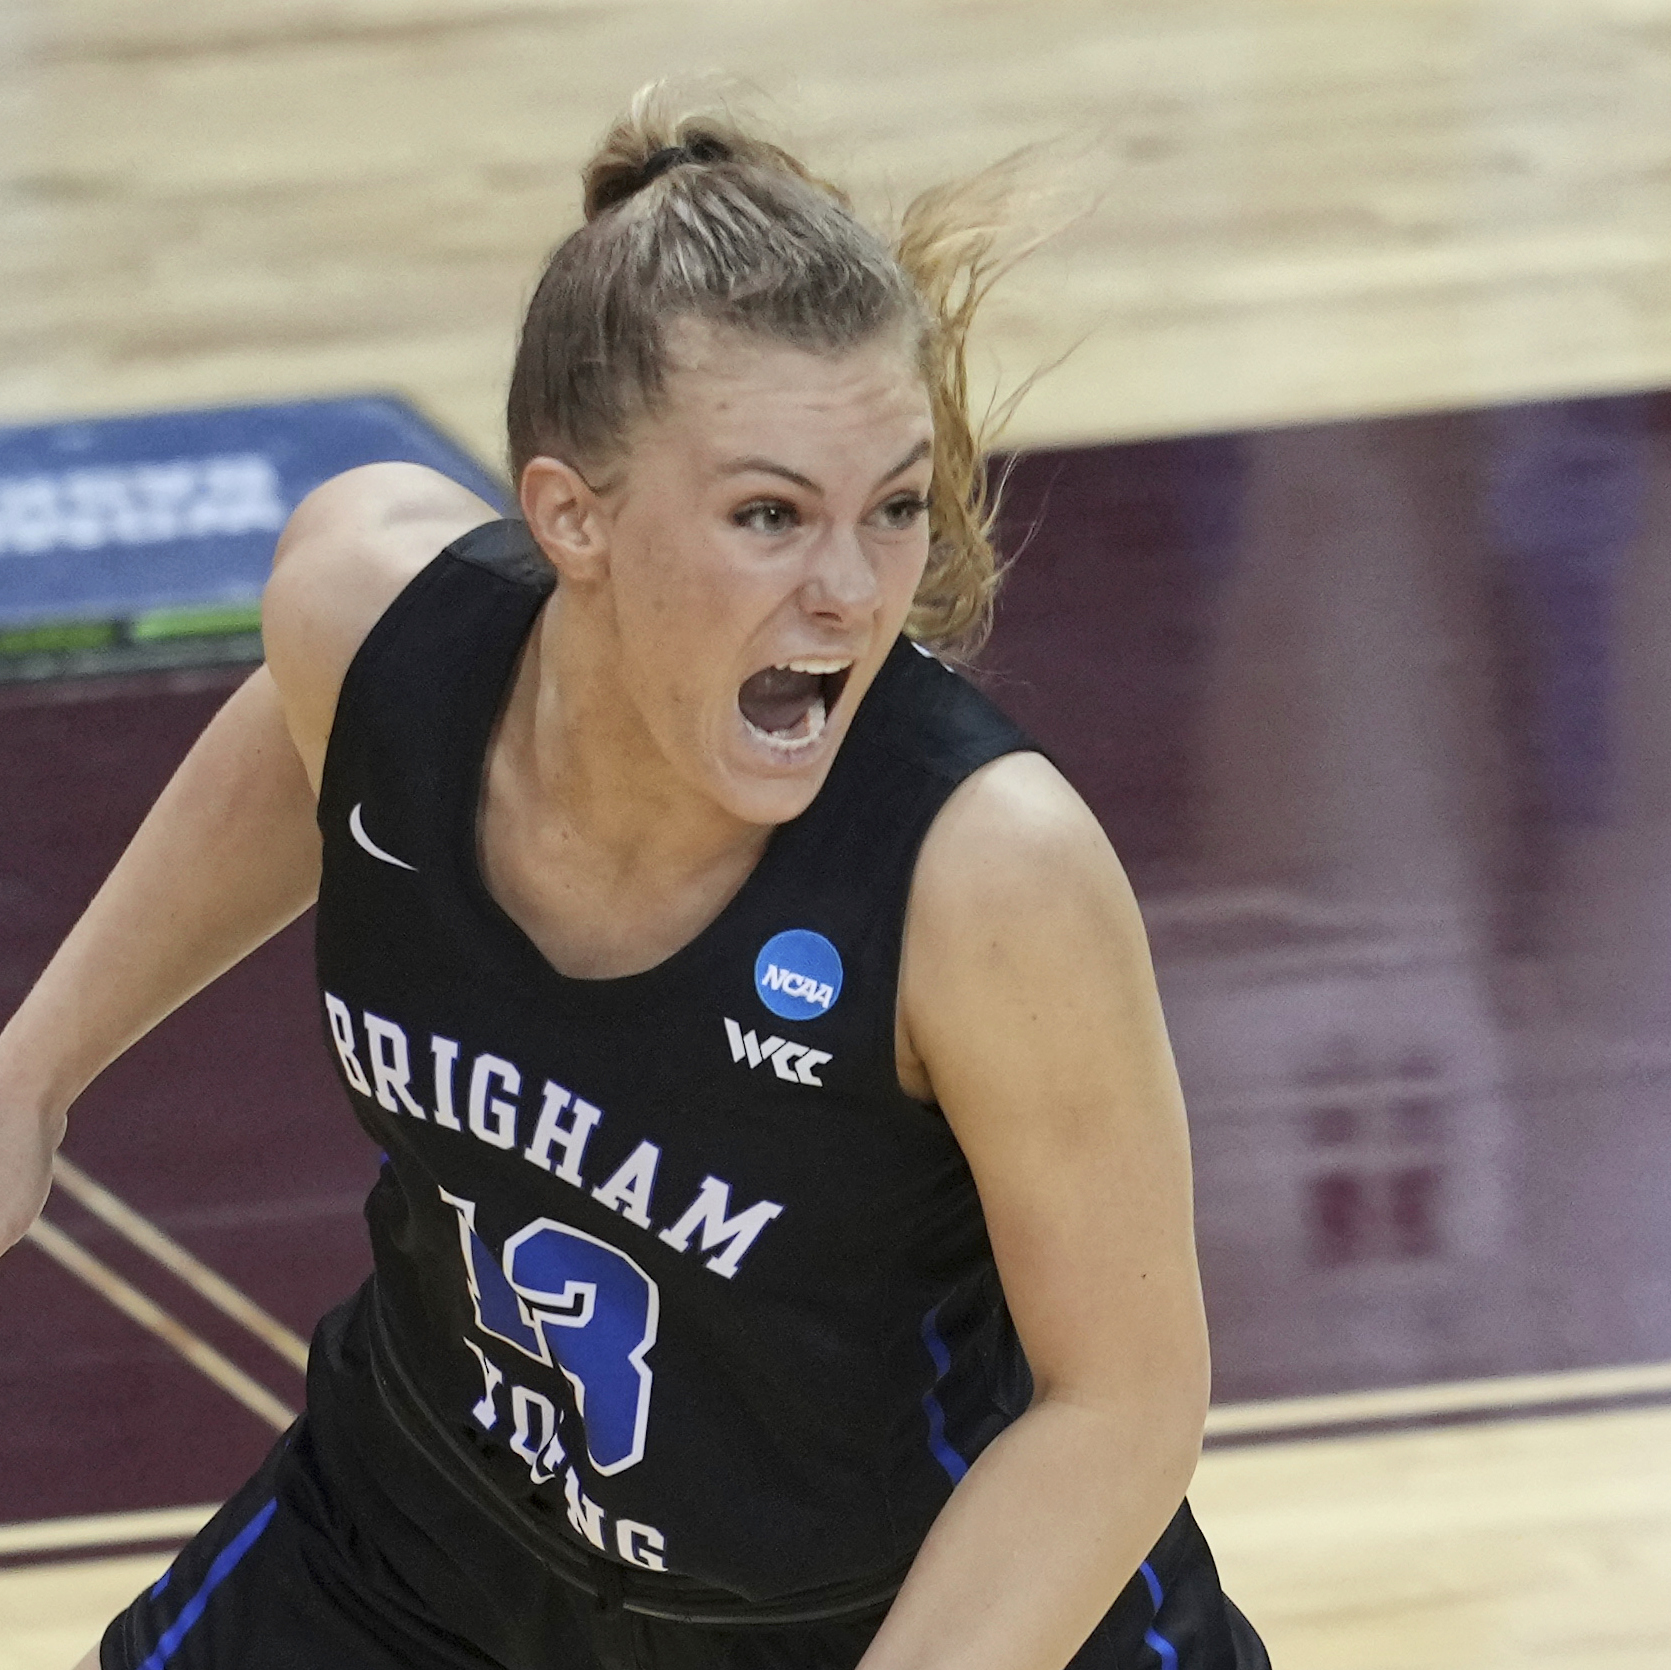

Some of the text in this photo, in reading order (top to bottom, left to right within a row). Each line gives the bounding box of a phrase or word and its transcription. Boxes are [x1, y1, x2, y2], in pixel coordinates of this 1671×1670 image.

[723, 1016, 834, 1088] WCC
[761, 963, 835, 1010] NCAA
[324, 990, 787, 1280] BRIGHAM
[437, 1184, 661, 1478] 13
